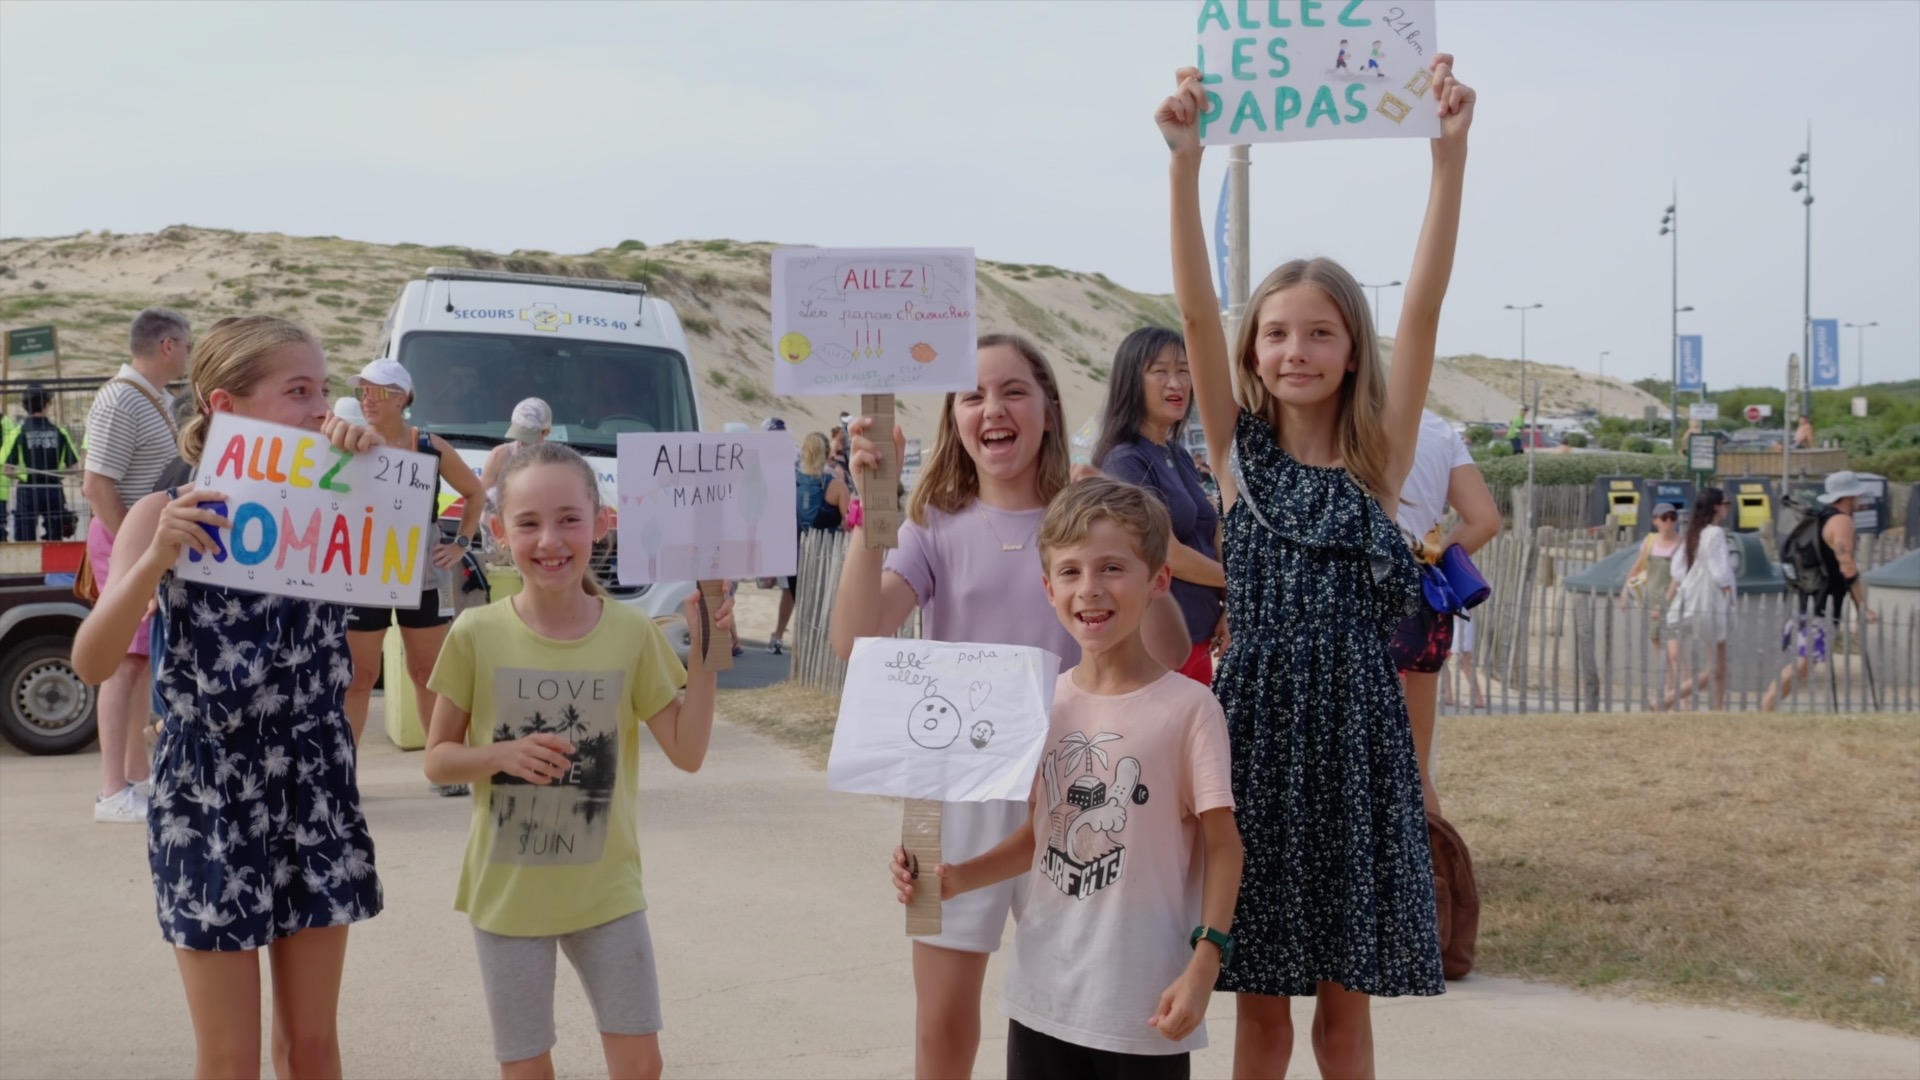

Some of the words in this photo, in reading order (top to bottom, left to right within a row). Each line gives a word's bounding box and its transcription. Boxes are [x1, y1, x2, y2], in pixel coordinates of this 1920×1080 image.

[1197, 0, 1372, 34] ALLEZ
[1382, 7, 1414, 36] 21
[1405, 30, 1423, 56] km
[1197, 37, 1291, 84] LES
[1197, 83, 1368, 138] PAPAS
[454, 309, 515, 319] SECOURS
[577, 315, 608, 328] FFSS
[611, 320, 628, 331] 40
[839, 310, 892, 328] papas
[215, 433, 354, 493] ALLEZ
[373, 455, 405, 485] 21
[409, 462, 432, 492] km
[652, 442, 744, 477] ALLER
[673, 483, 733, 508] MANU!
[518, 678, 605, 701] LOVE
[518, 834, 576, 856] SUN
